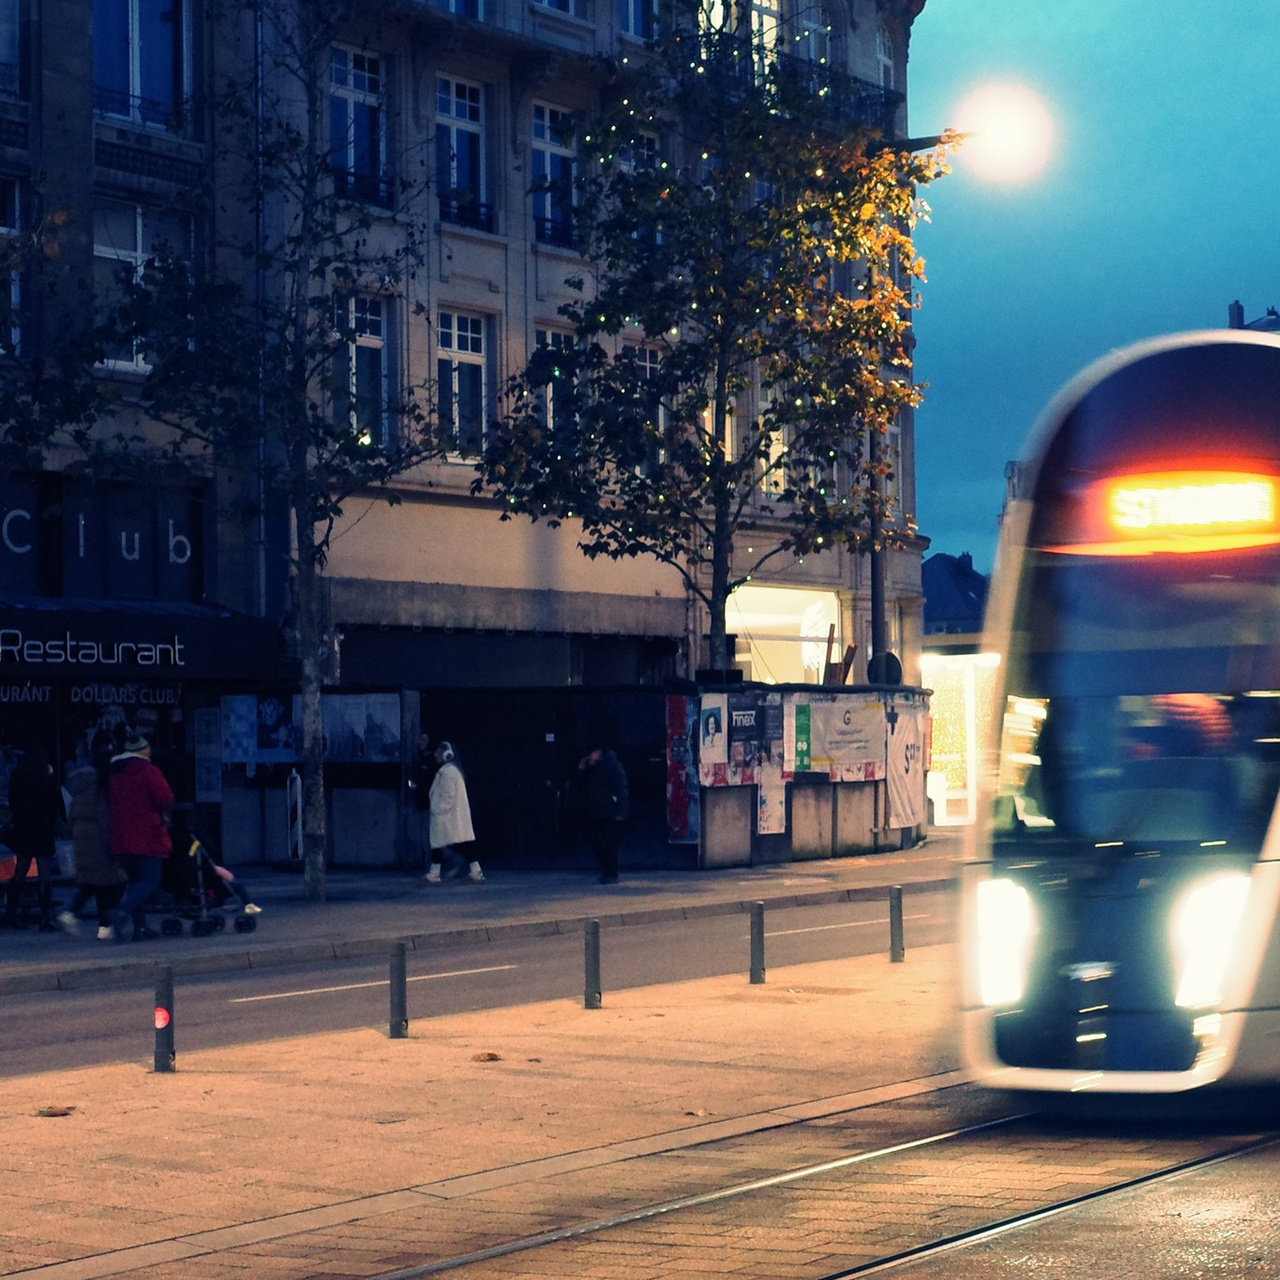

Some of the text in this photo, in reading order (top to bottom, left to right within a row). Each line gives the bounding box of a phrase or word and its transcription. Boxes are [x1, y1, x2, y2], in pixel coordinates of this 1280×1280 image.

[2, 509, 192, 564] Club
[0, 629, 186, 666] Restaurant
[71, 686, 137, 704] DOLLARS
